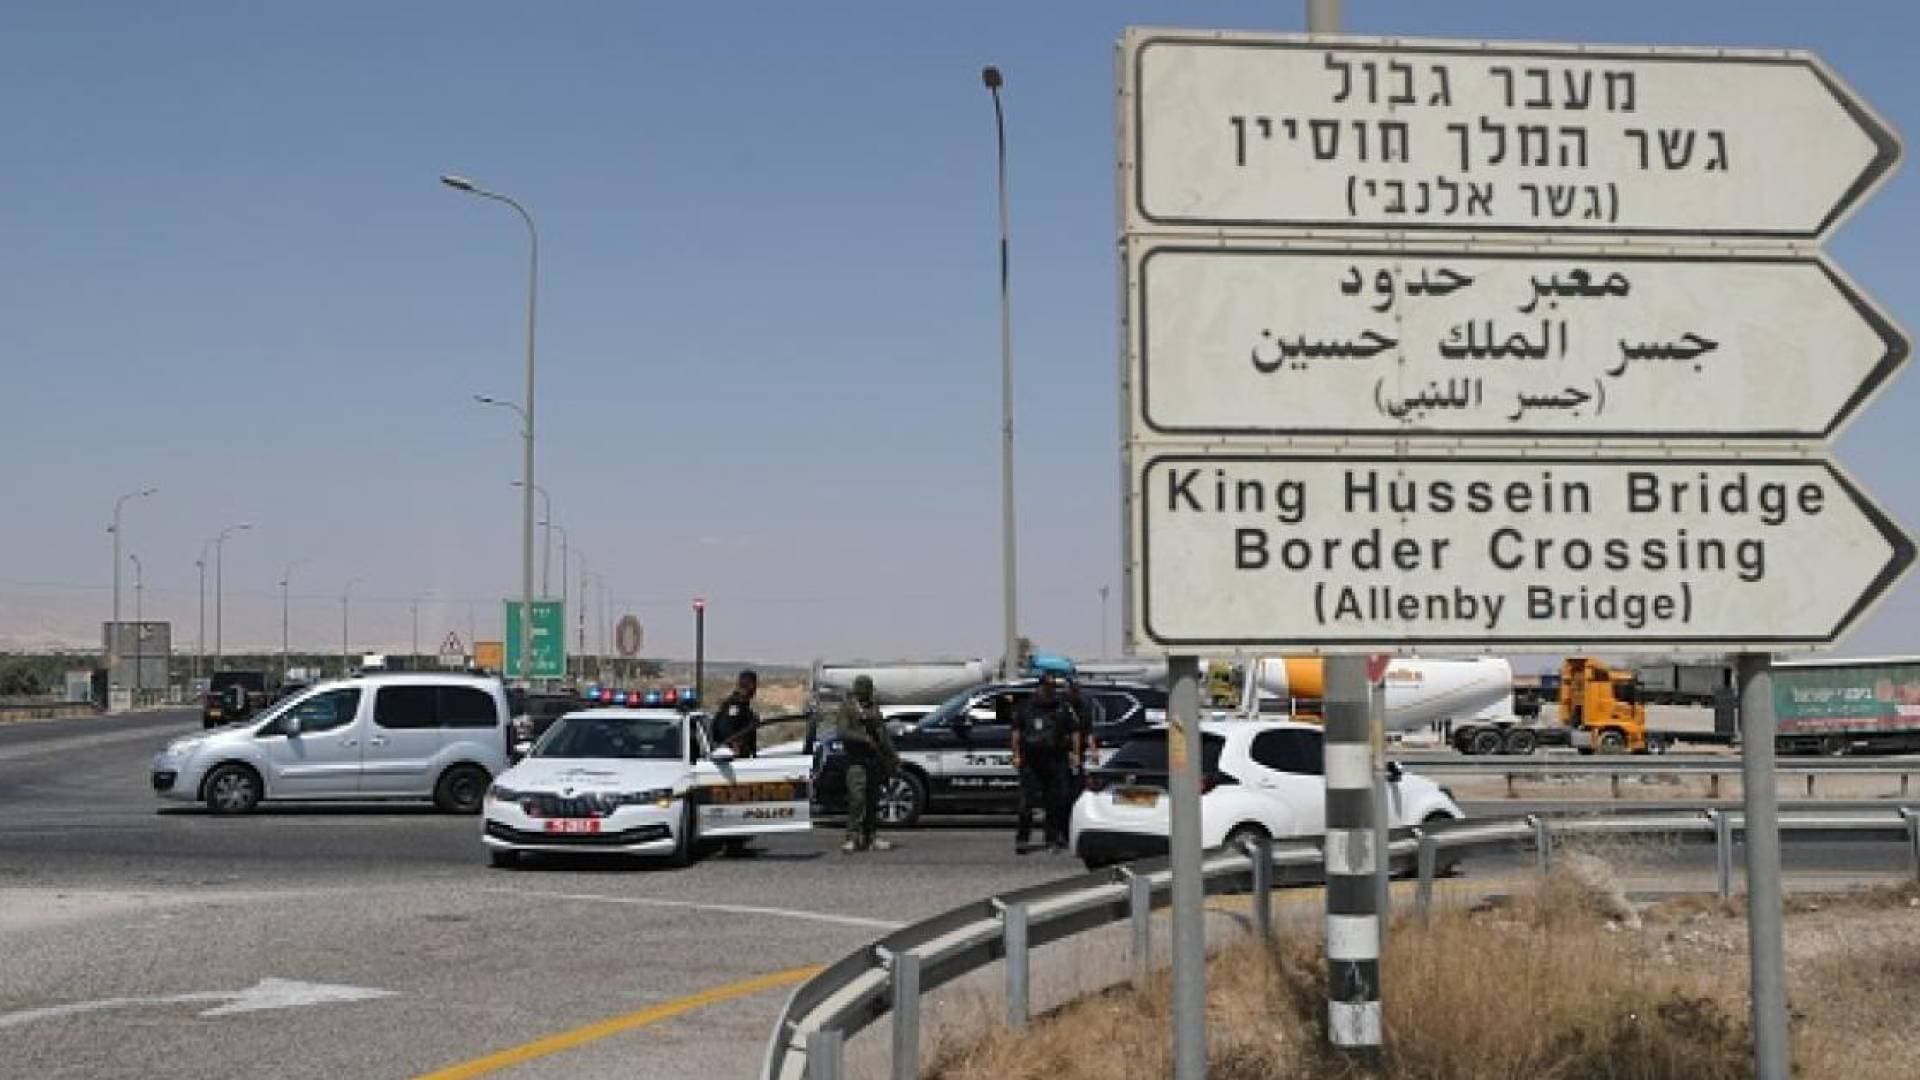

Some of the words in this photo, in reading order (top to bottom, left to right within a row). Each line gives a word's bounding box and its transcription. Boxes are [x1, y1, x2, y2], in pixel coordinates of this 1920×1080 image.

[1325, 52, 1452, 107] גבול
[1491, 67, 1636, 111] מעבר
[1230, 116, 1410, 167] חוסיין
[1447, 115, 1588, 172] המלך
[1624, 129, 1730, 171] גשר
[1346, 175, 1494, 217] אלנבי)
[1520, 182, 1619, 223] (גשר
[1341, 266, 1474, 313] حدود
[1518, 268, 1631, 314] معبر
[1251, 330, 1399, 375] حسين
[1438, 319, 1567, 361] الملك
[1607, 332, 1719, 377] جسر
[1374, 377, 1483, 423] اللنبي)
[1508, 377, 1606, 421] (جسر
[1168, 468, 1307, 524] King
[1344, 471, 1590, 514] Hussein
[1627, 471, 1826, 526] Bridge
[1235, 528, 1451, 571] Border
[1489, 528, 1766, 583] Crossing
[1315, 581, 1506, 629] (Allenby
[1527, 581, 1692, 629] Bridge)
[742, 807, 794, 819] POLICE
